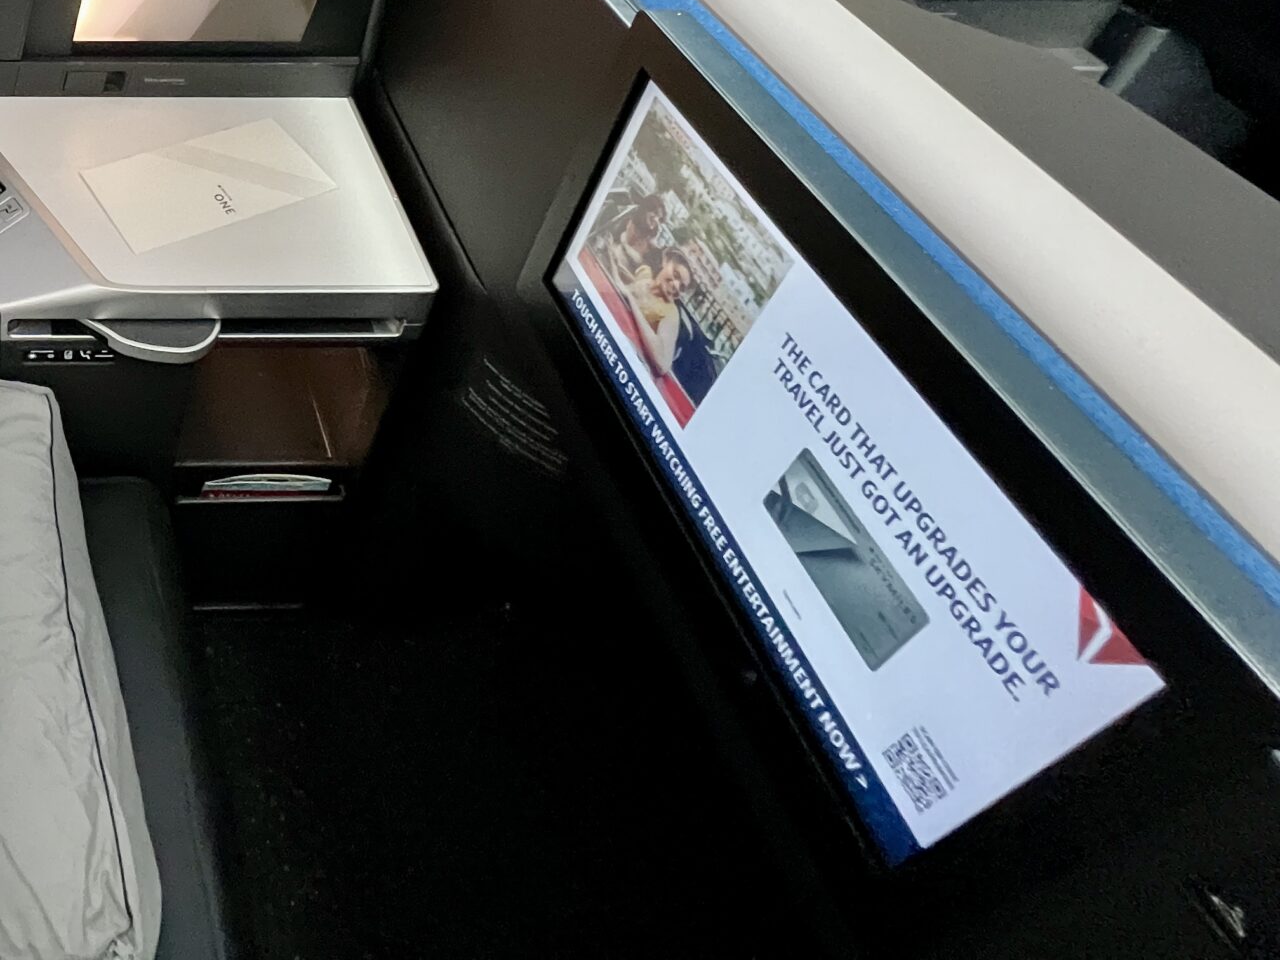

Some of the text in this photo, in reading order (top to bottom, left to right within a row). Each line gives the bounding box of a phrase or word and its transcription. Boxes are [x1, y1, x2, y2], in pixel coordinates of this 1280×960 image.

[214, 193, 236, 215] ONE
[570, 288, 598, 333] TOUCH
[594, 329, 620, 368] HERE
[614, 363, 629, 384] TO
[624, 381, 656, 427] START
[650, 423, 704, 510] WATCHING
[698, 506, 729, 552] FREE
[722, 548, 826, 710] ENTERTAINMENT
[817, 710, 863, 772] NOW
[773, 357, 826, 434] TRAVEL
[822, 430, 866, 479] JUST
[861, 480, 903, 527] GOT
[894, 529, 929, 567] AN
[924, 564, 1027, 703] UPGRADE.
[780, 331, 812, 375] THE
[808, 370, 852, 426] CARD
[850, 422, 898, 481] THAT
[892, 480, 998, 613] UPGRADES
[994, 609, 1061, 697] YOUR
